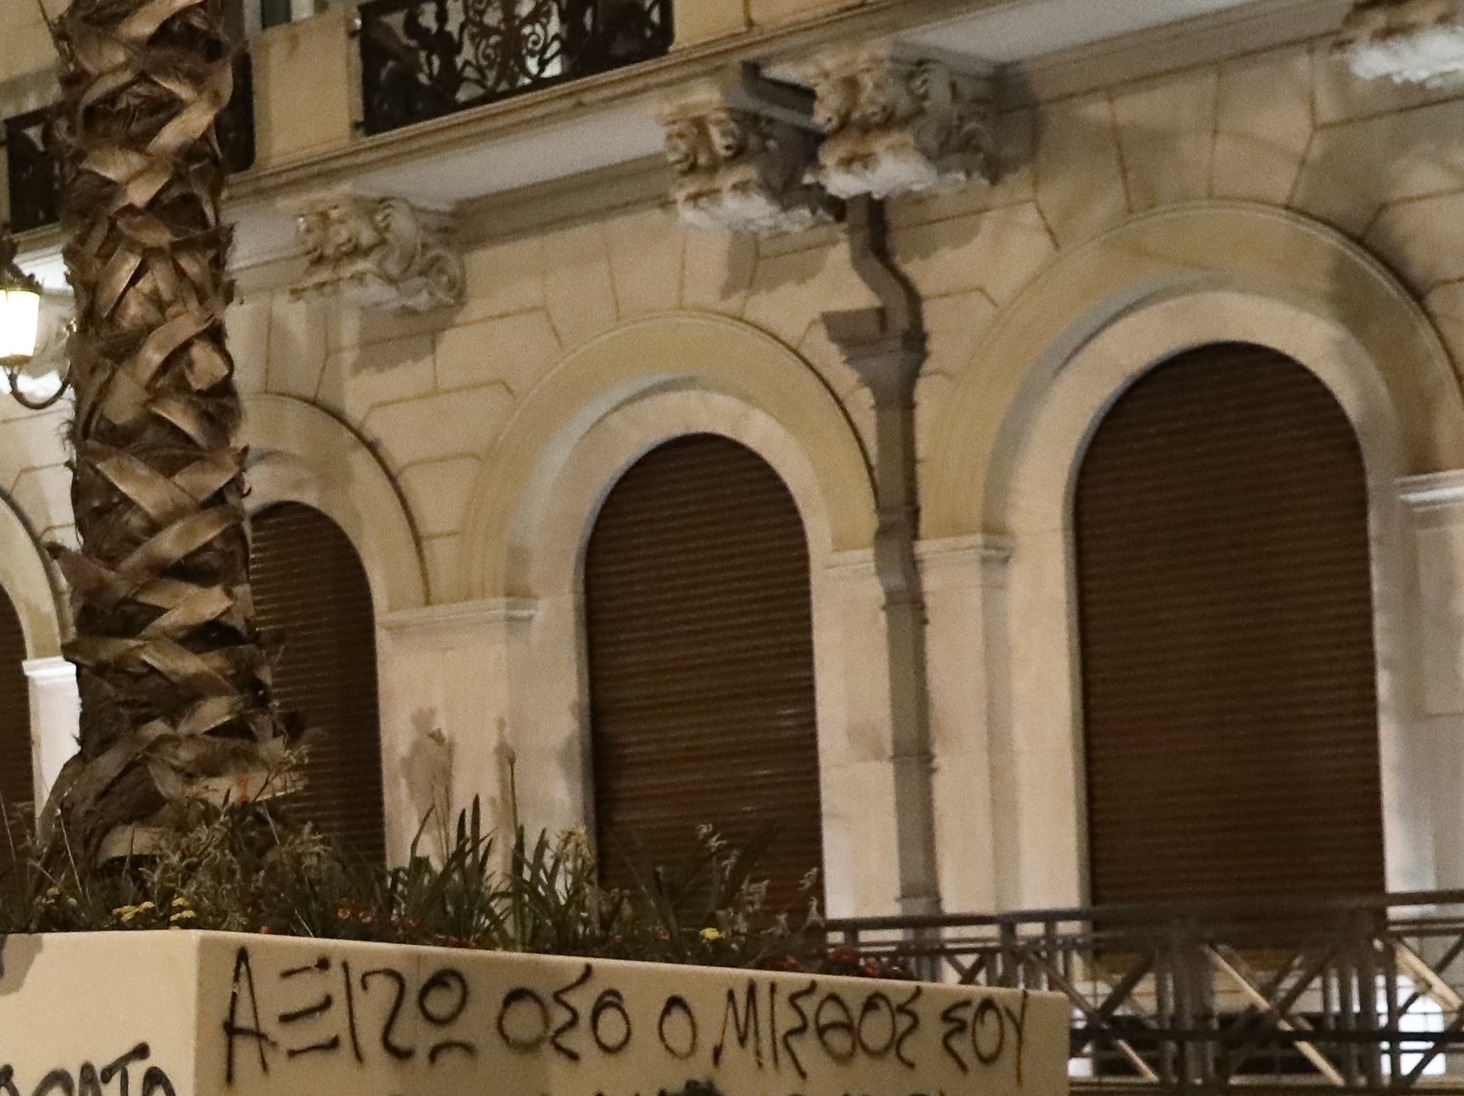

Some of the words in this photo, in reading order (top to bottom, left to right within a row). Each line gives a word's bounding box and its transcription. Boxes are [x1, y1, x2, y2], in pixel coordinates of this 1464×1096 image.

[496, 962, 632, 1063] ΟΣΟ
[657, 994, 699, 1061] Ο
[712, 977, 923, 1081] ΜΙΣΘΟΣ
[939, 987, 1029, 1087] ΣΟΥ
